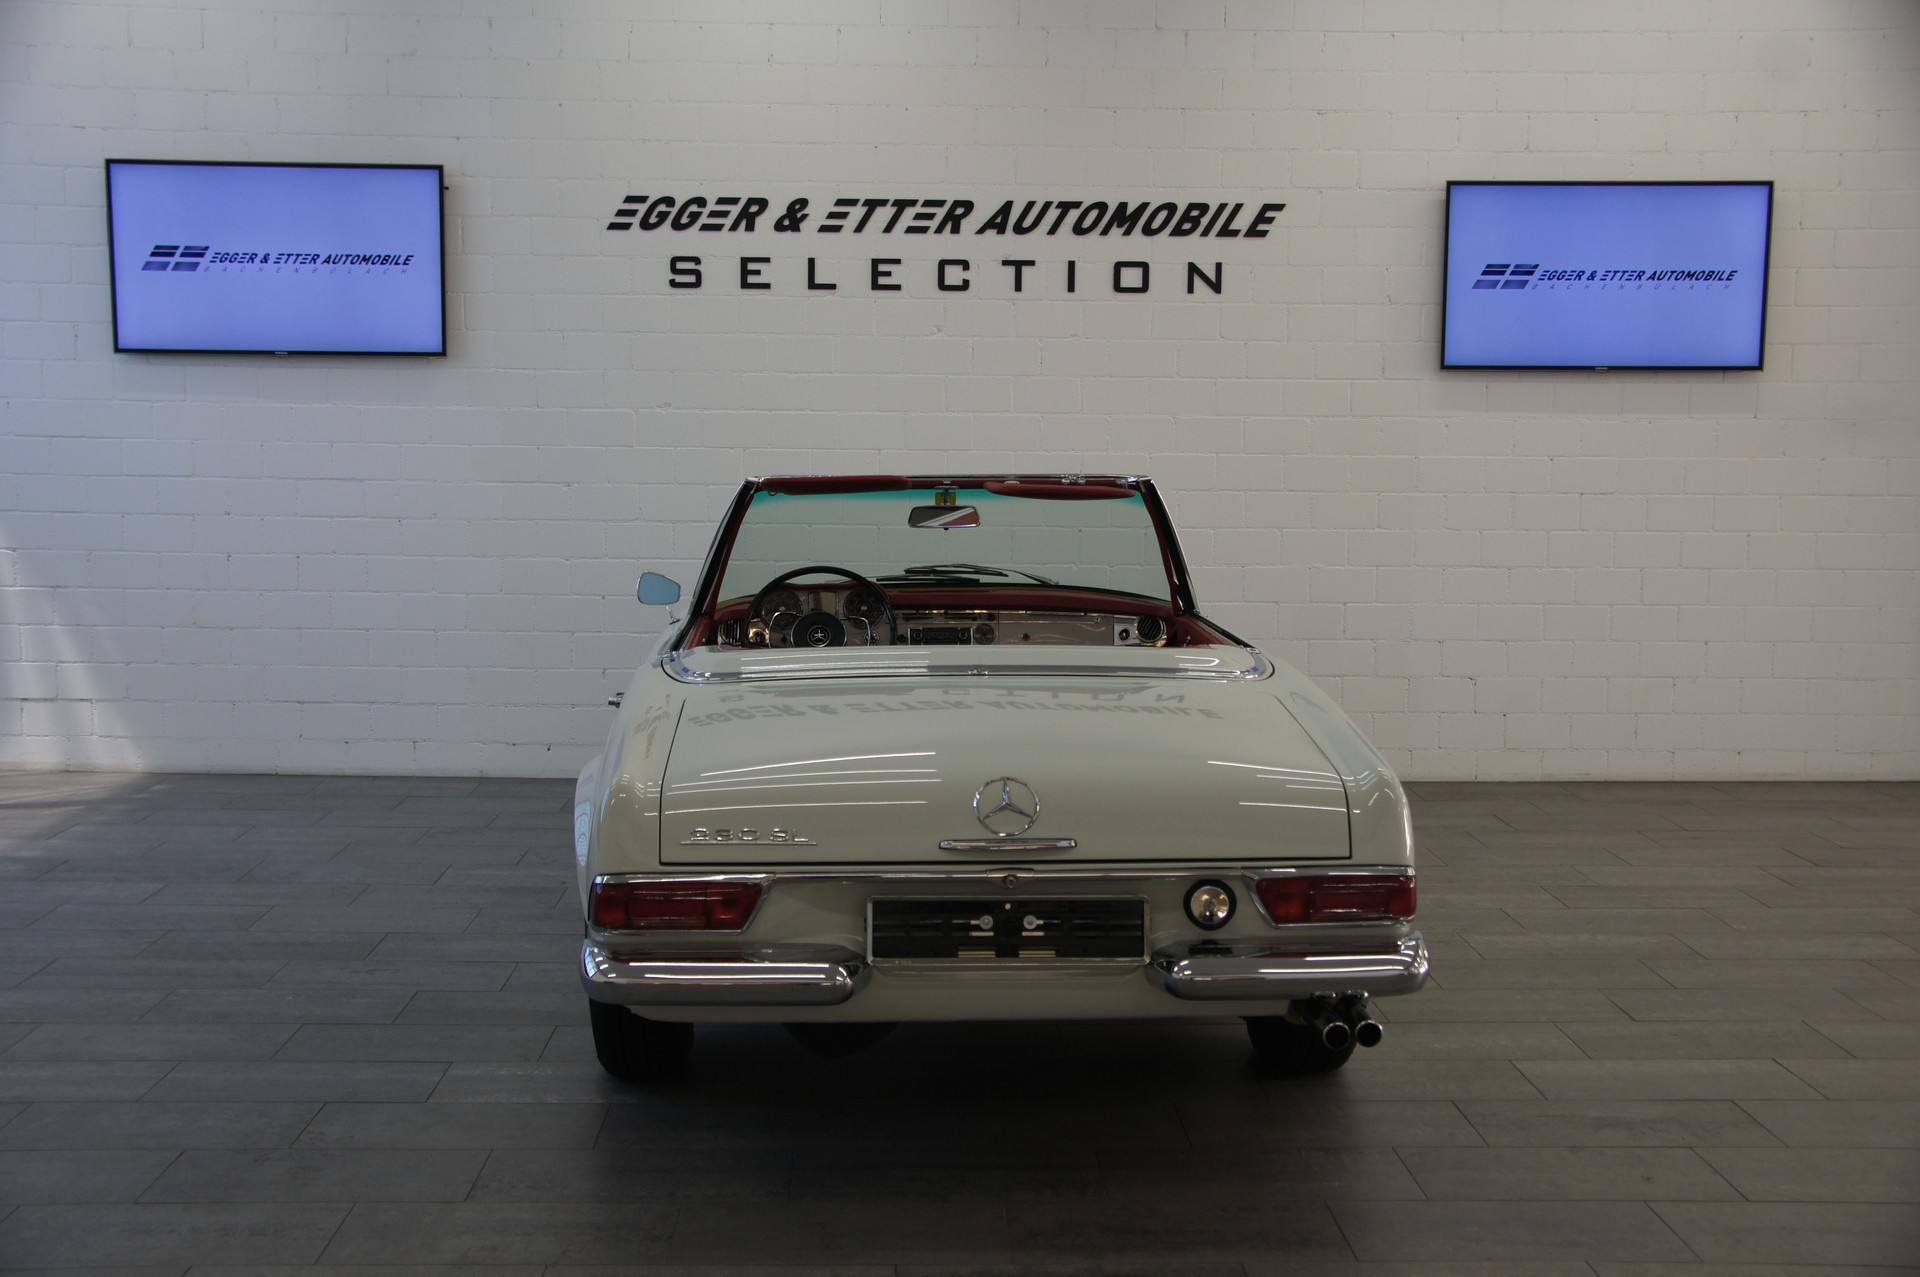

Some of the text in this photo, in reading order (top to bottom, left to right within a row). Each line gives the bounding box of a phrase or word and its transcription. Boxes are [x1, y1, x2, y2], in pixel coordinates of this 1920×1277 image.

[606, 194, 1287, 238] EGGER & ETTER AUTOMOBILE
[210, 252, 415, 266] EGGER & ETTER AUTOMOBILE
[668, 256, 1223, 295] SELECTION
[1538, 270, 1738, 282] EGGER & ETTER AUTOMOBILE
